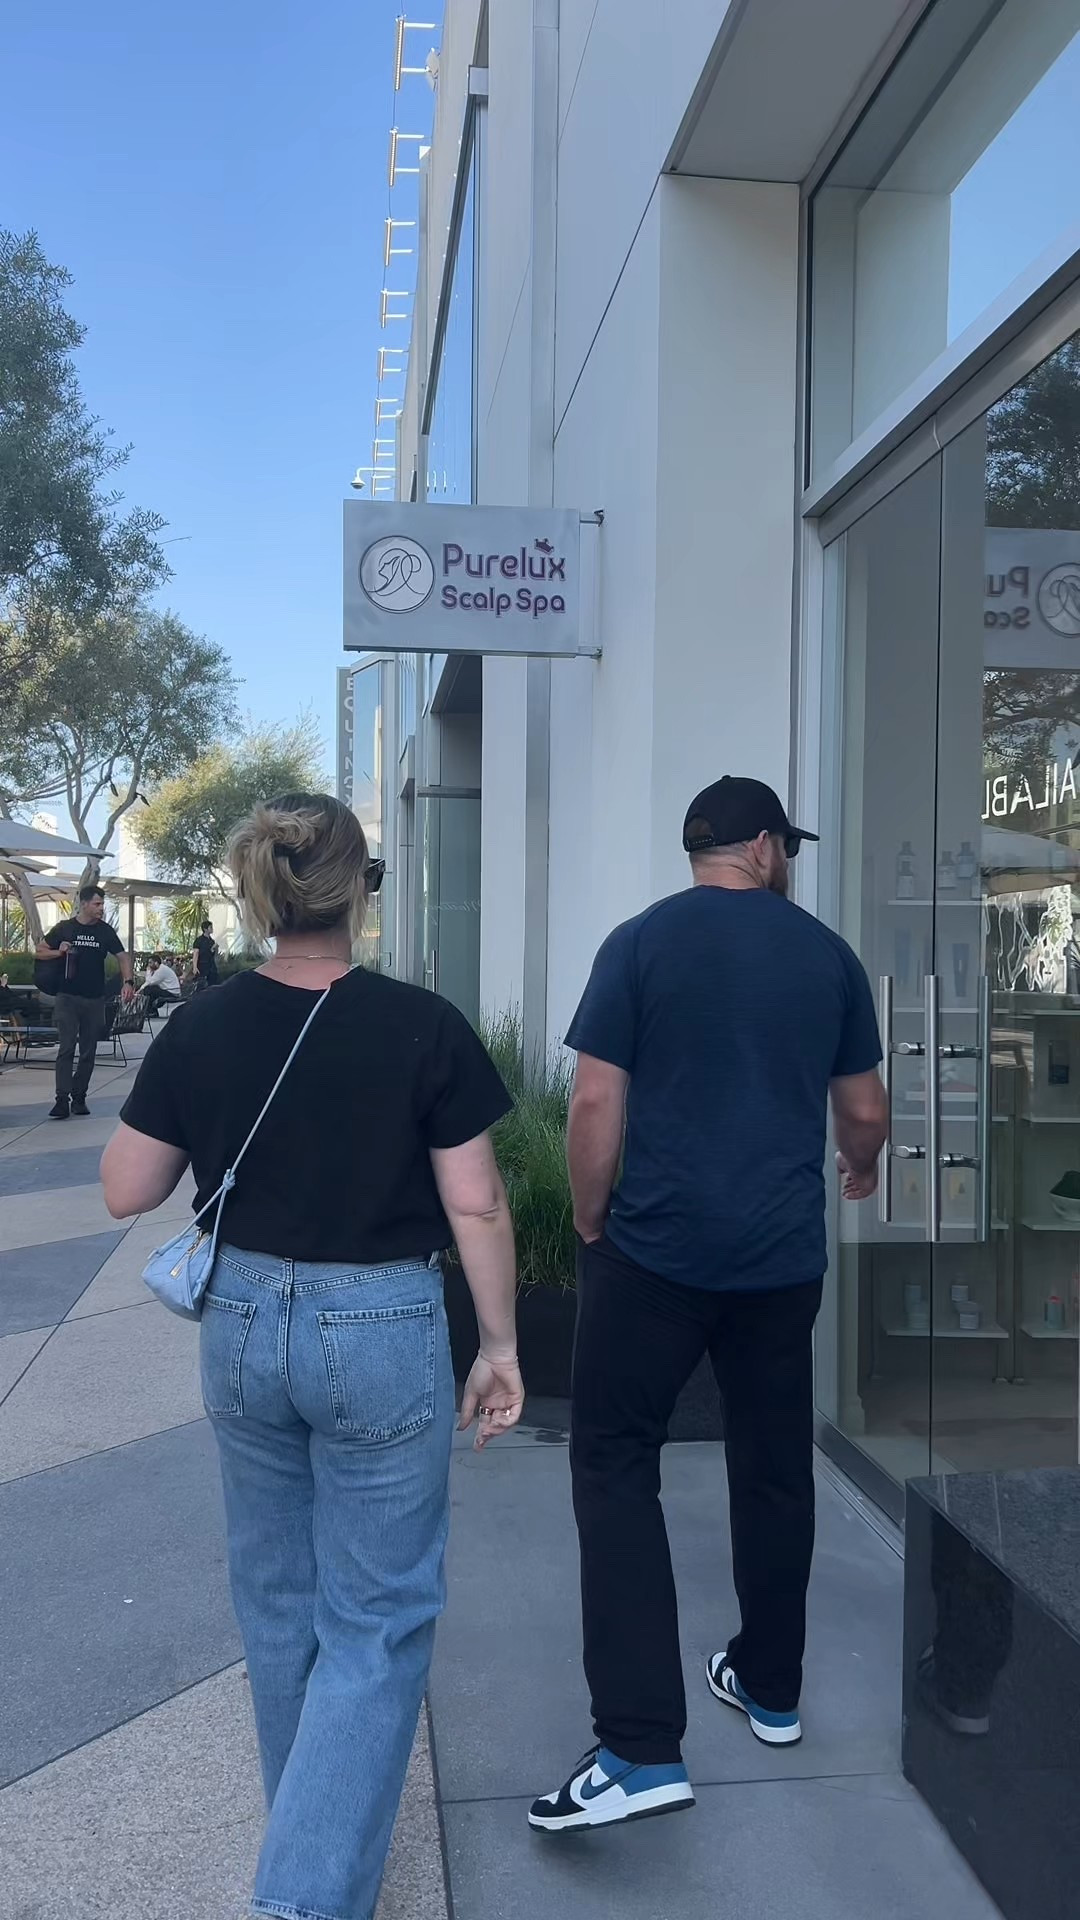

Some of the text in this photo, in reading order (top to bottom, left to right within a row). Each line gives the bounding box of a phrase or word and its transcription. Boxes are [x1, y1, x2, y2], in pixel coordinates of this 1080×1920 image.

[442, 542, 567, 581] Purelux
[441, 584, 567, 619] Scalp Spa
